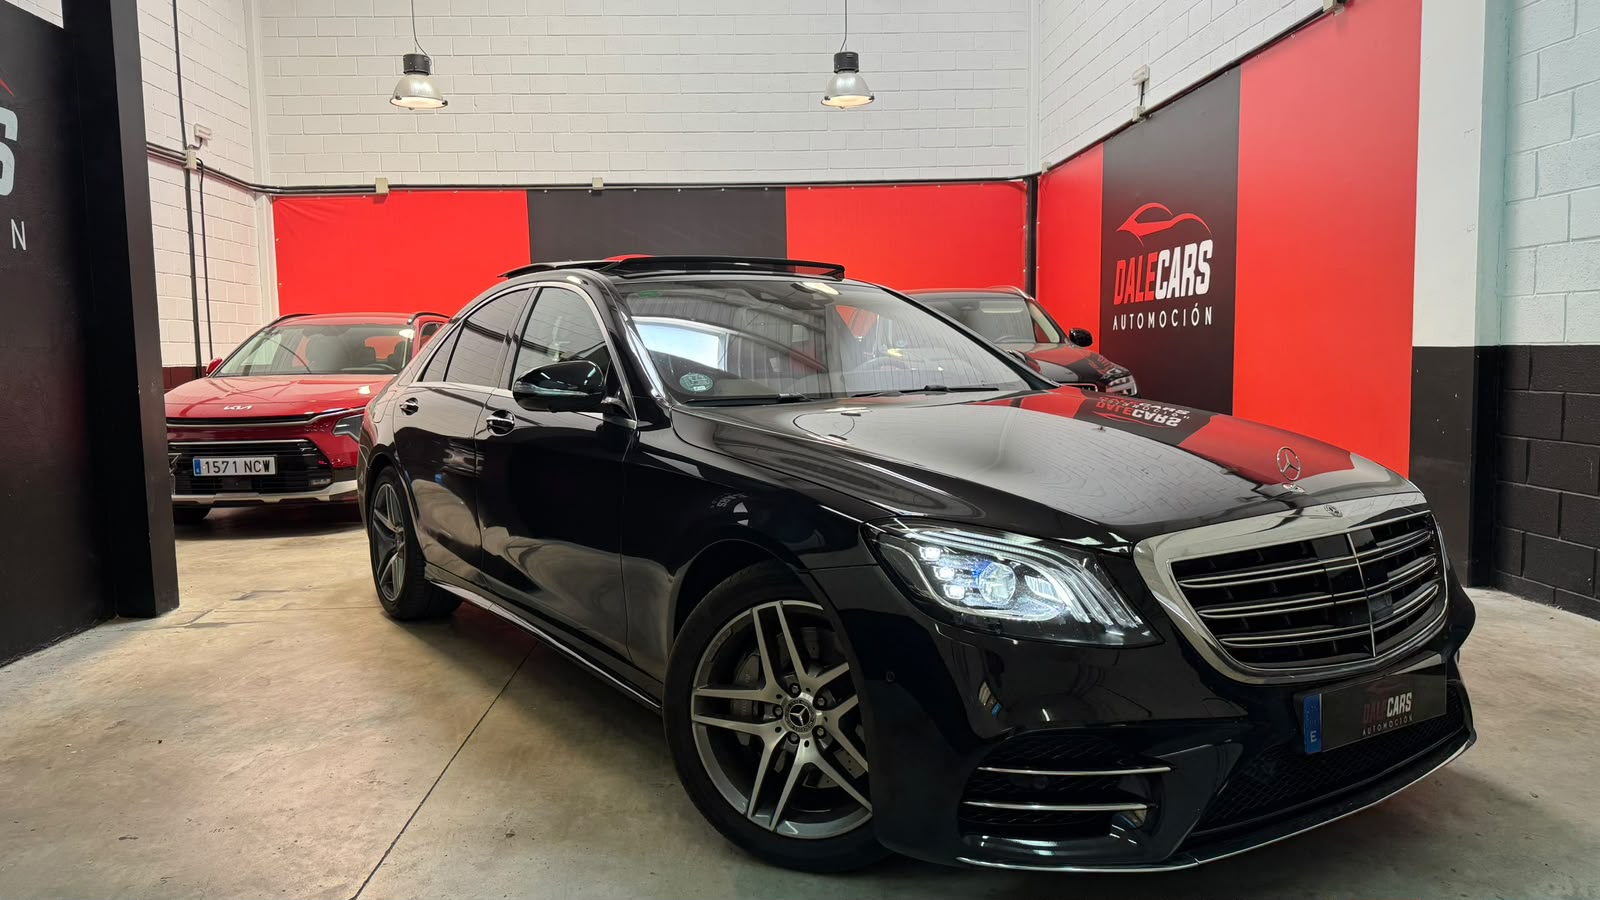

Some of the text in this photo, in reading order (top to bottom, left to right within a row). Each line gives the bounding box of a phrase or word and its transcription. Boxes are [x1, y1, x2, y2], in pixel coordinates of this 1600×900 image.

[1113, 239, 1213, 305] DALECARS
[1112, 302, 1213, 331] AUTOMOCIÓN
[205, 459, 271, 474] 1571 NCW
[1310, 730, 1318, 743] E
